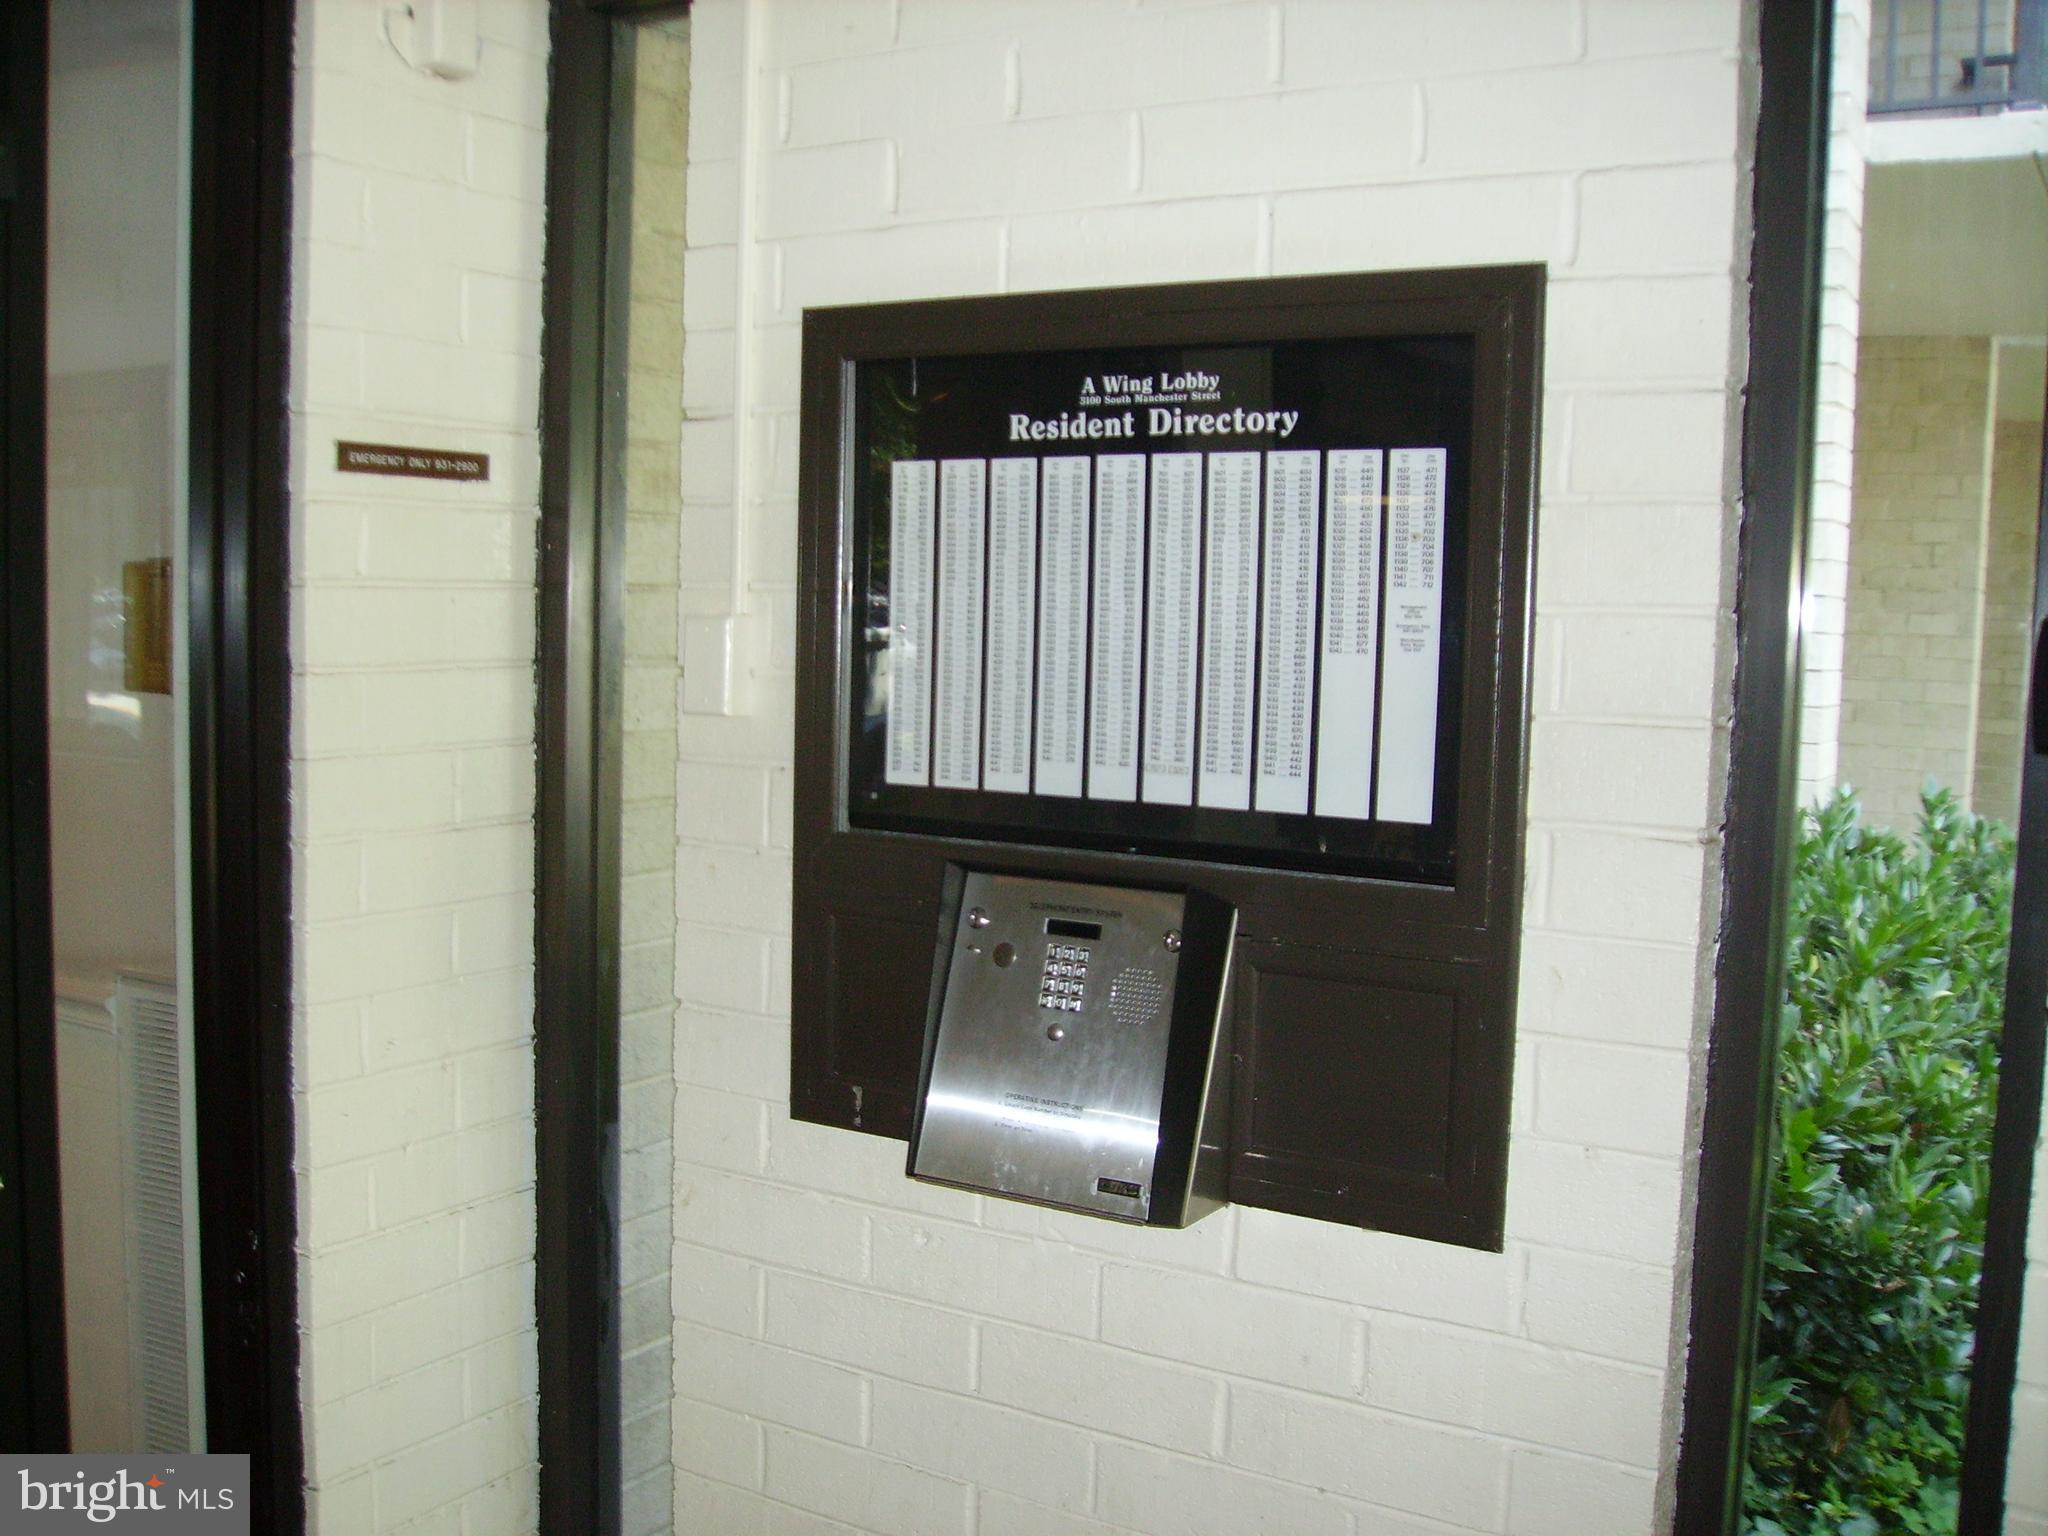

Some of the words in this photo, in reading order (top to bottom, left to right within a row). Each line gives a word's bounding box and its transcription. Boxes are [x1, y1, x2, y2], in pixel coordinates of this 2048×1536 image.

[1081, 376, 1096, 394] A
[1102, 374, 1153, 393] Wing
[1161, 371, 1220, 392] Lobby
[1101, 394, 1132, 405] South
[1134, 392, 1188, 404] Manchester
[1191, 390, 1221, 401] Street
[1009, 411, 1136, 441] Resident
[1148, 406, 1299, 438] Directory
[350, 451, 405, 467] EMERGENCY
[408, 456, 432, 469] ONLY
